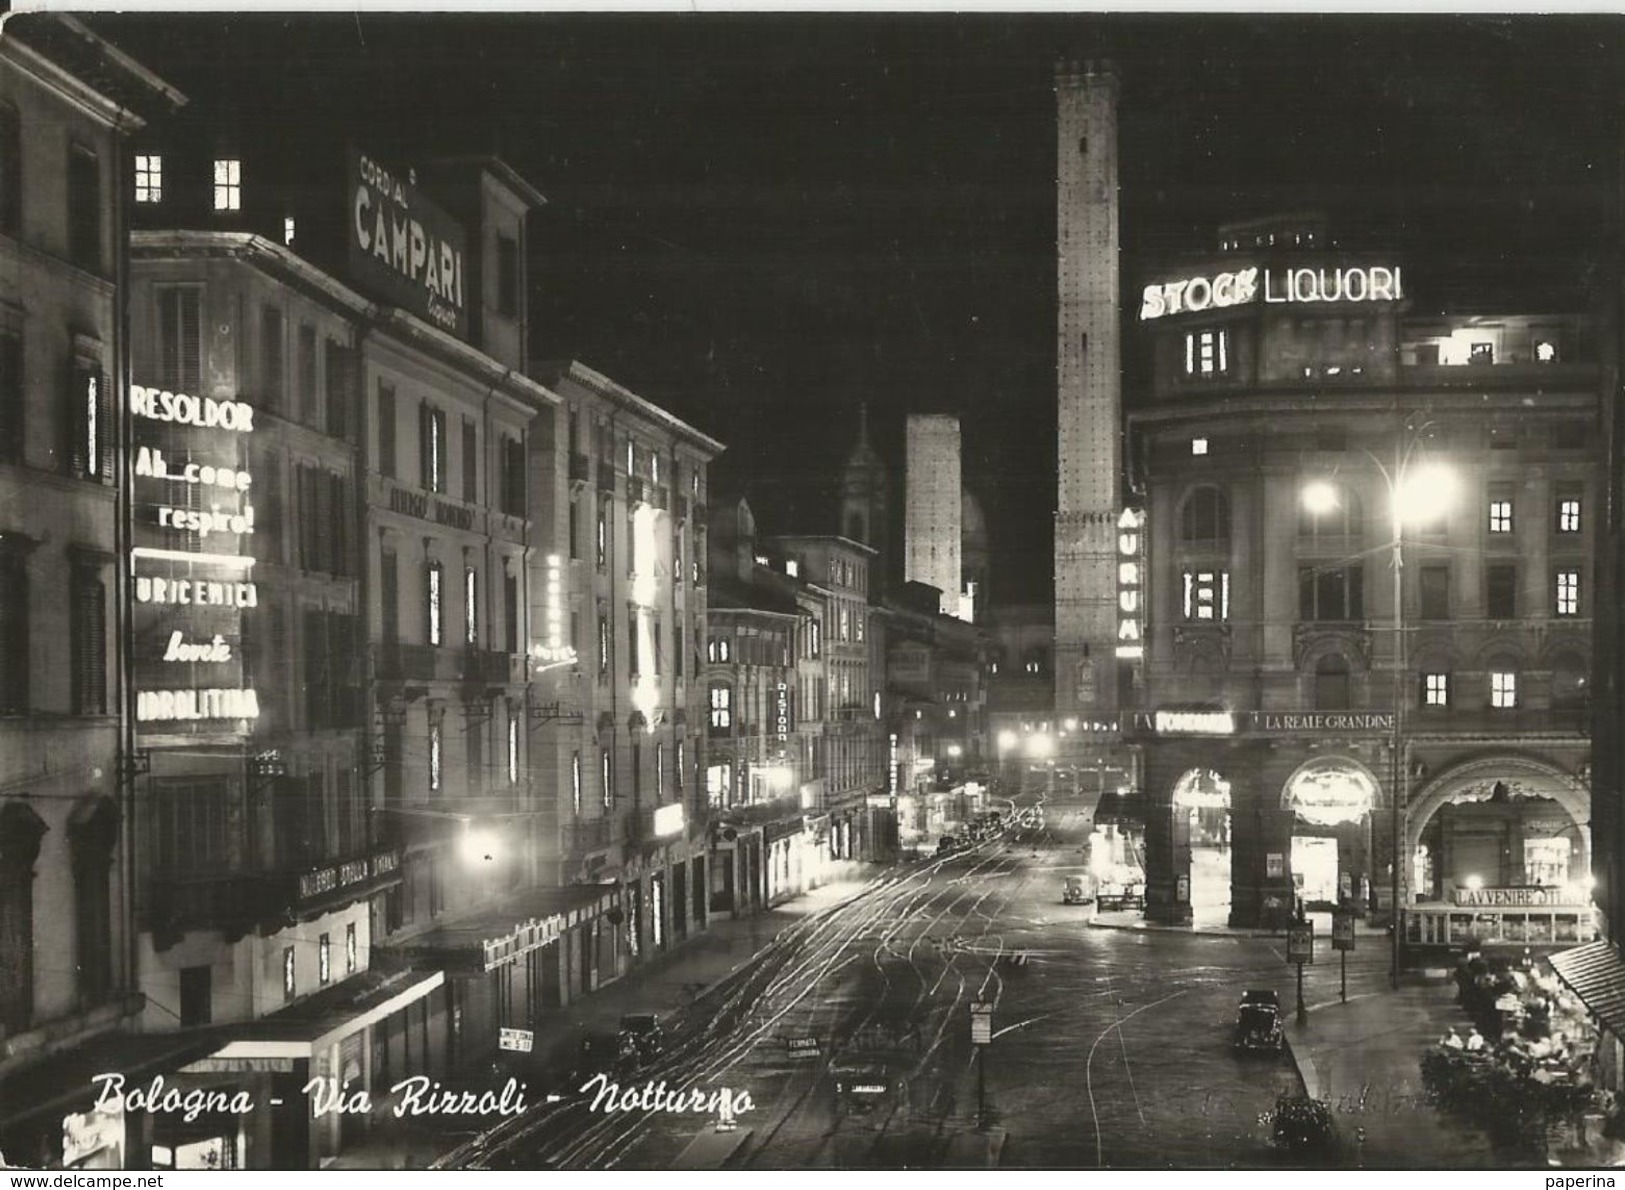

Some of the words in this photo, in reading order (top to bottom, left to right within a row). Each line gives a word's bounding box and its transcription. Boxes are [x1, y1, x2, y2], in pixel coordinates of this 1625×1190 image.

[360, 155, 408, 209] CORDIAL
[355, 185, 463, 307] CAMPARI
[1140, 266, 1258, 320] STOCK
[1264, 266, 1401, 303] LIQUORI
[130, 384, 253, 432] RESOLDOR
[1265, 715, 1281, 729] LA
[1283, 715, 1323, 729] REALE
[1325, 715, 1395, 729] GRANDINE
